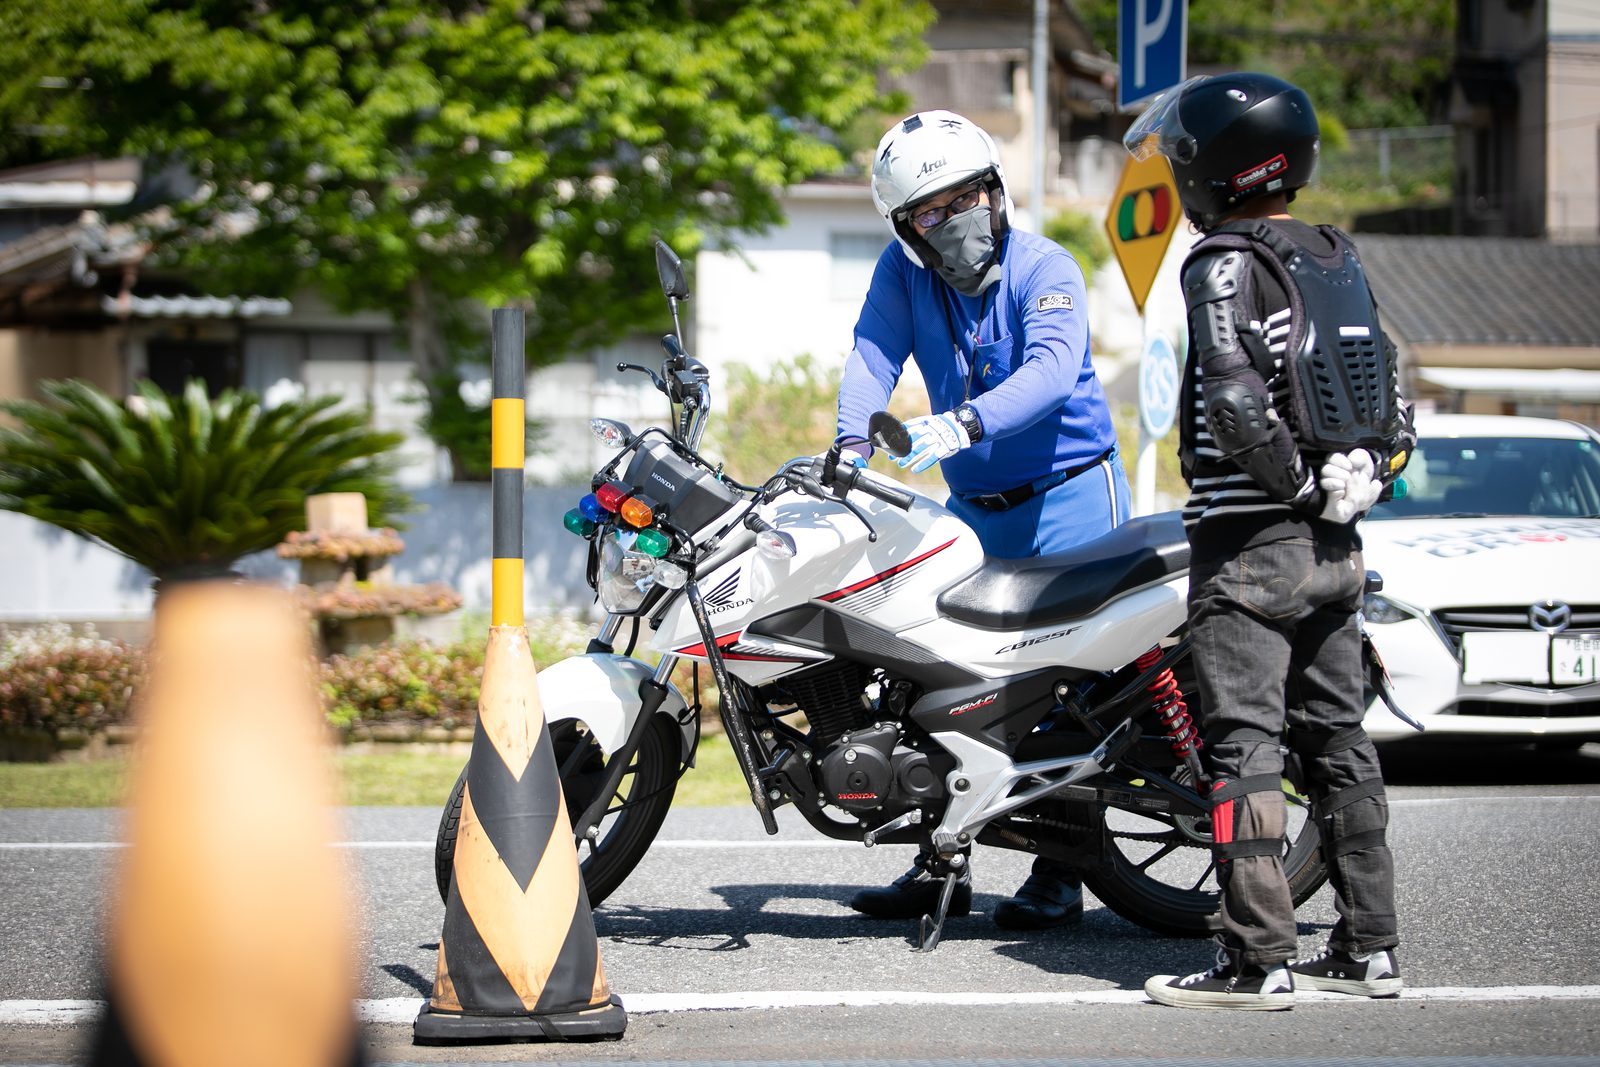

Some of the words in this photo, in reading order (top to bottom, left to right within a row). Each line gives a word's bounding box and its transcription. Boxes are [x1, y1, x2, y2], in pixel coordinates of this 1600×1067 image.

[1135, 0, 1173, 89] P
[917, 155, 948, 179] Arai
[651, 471, 676, 492] HONDA
[707, 597, 755, 616] HONDA
[995, 625, 1084, 655] CB125F
[837, 792, 878, 800] HONDA
